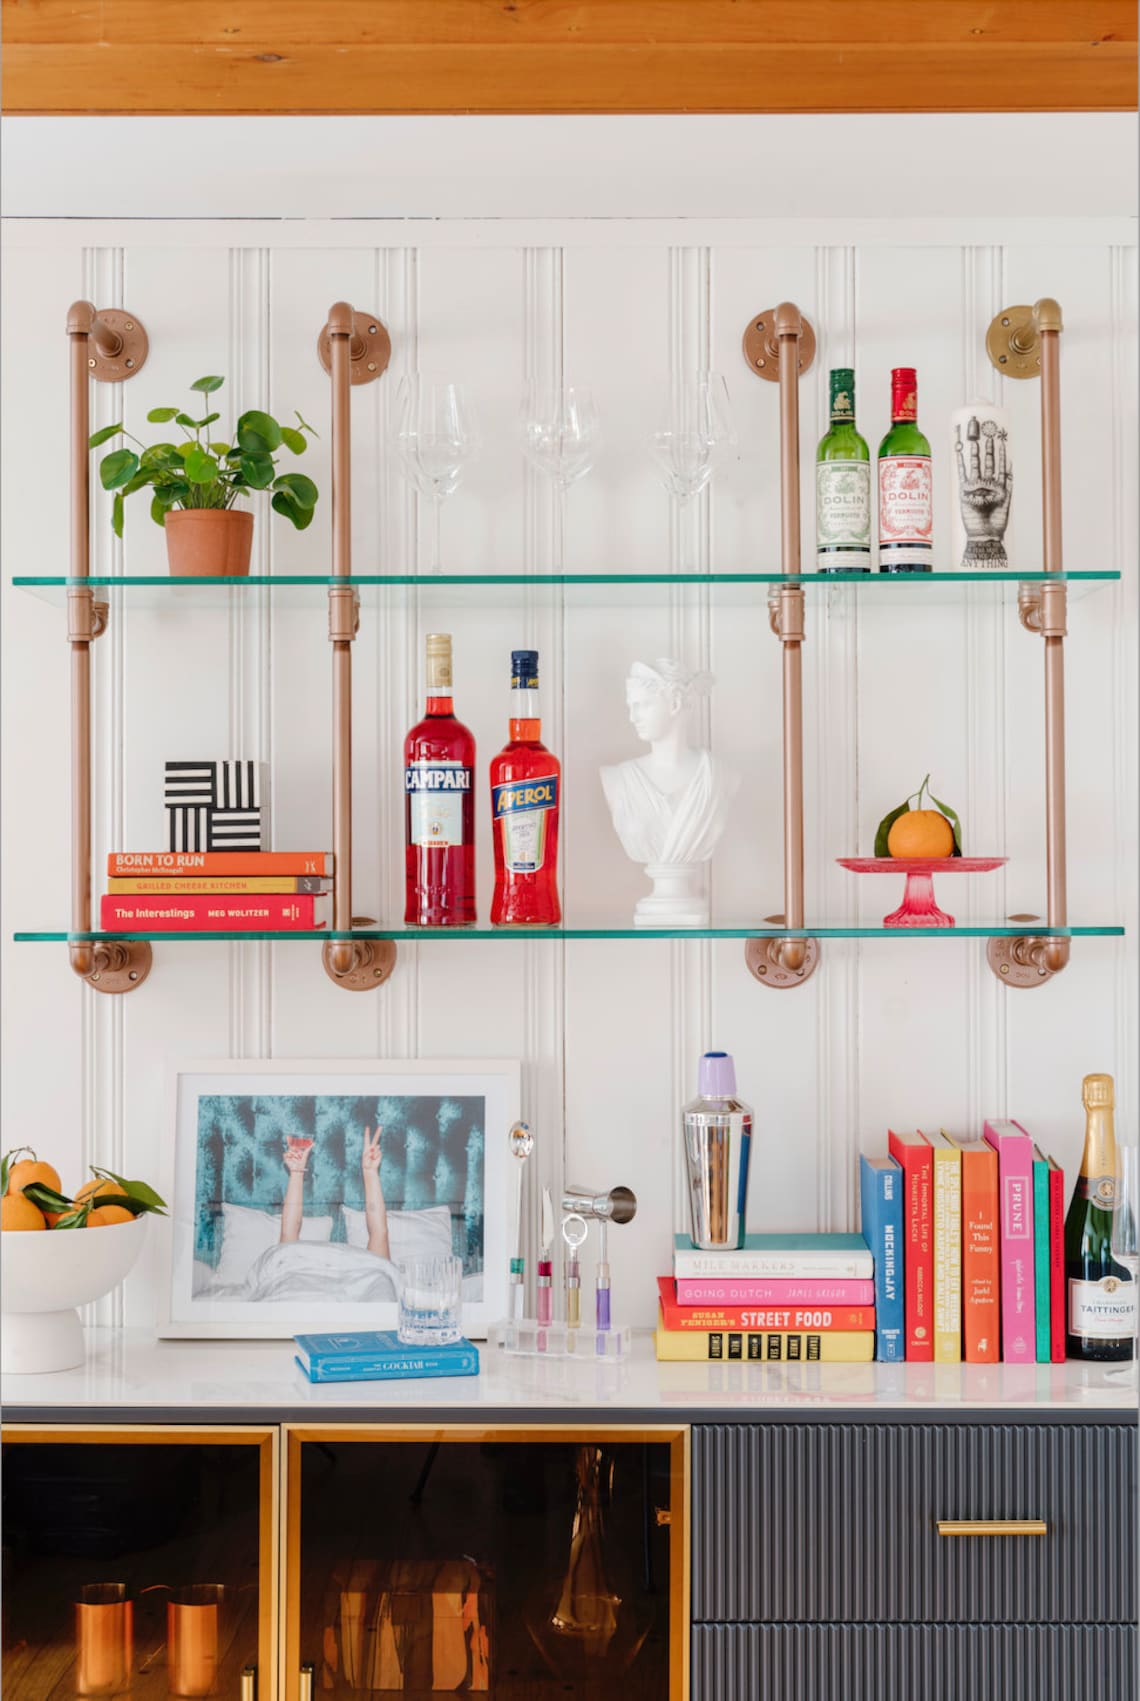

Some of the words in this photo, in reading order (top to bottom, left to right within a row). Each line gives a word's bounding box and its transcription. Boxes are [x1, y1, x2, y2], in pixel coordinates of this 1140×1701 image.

[823, 496, 865, 504] DOLIN
[888, 492, 928, 500] DOLIN
[960, 559, 1008, 568] ANYTHING
[405, 770, 470, 789] CAMPARI
[497, 785, 553, 812] APEROL
[116, 854, 153, 866] BORN
[156, 854, 174, 866] TO
[177, 855, 205, 867] RUN
[136, 882, 172, 890] GRILLED
[115, 908, 134, 918] The
[136, 908, 195, 919] Interestings
[228, 909, 270, 917] WOLITZER
[921, 1164, 929, 1180] THE
[884, 1175, 893, 1200] COLLINS
[912, 1174, 920, 1215] HENRIETTA
[921, 1183, 929, 1220] IMMORTAL
[1012, 1183, 1023, 1232] PRUNE
[978, 1210, 983, 1220] I
[921, 1223, 929, 1239] LIFE
[968, 1221, 993, 1230] Found
[972, 1233, 989, 1241] This
[968, 1244, 993, 1254] Funny
[884, 1225, 896, 1300] MOCKINGJAY
[685, 1289, 726, 1298] GOING
[730, 1289, 772, 1297] DUTCH
[741, 1312, 791, 1327] STREET
[795, 1312, 832, 1327] FOOD
[382, 1360, 424, 1371] COCKTAIL
